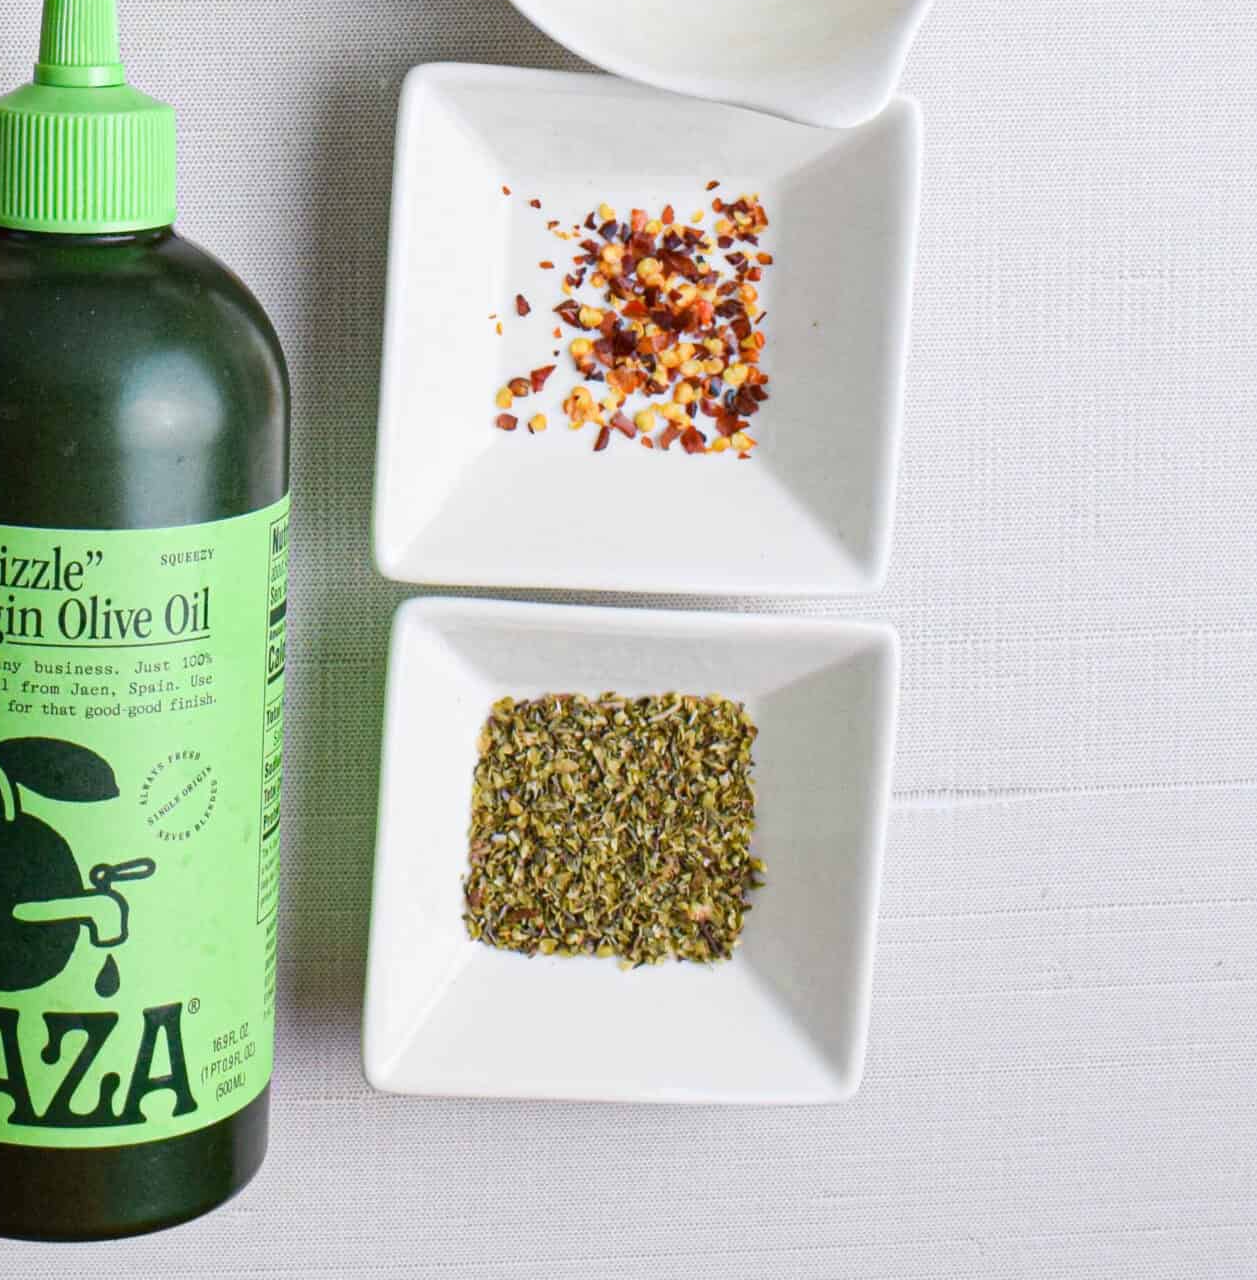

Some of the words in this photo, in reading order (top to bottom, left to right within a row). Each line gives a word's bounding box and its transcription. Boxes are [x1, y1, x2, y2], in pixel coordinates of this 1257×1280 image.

[160, 548, 215, 566] SQUEEZY
[57, 597, 153, 640] Olive
[164, 587, 211, 631] Oil
[34, 661, 120, 676] business.
[134, 661, 170, 674] Just
[183, 652, 213, 670] 100%
[22, 680, 61, 695] from
[129, 680, 180, 697] Spain.
[191, 674, 213, 688] Use
[8, 699, 33, 714] for
[41, 702, 77, 716] that
[85, 700, 162, 719] good-good
[169, 693, 217, 712] finish.
